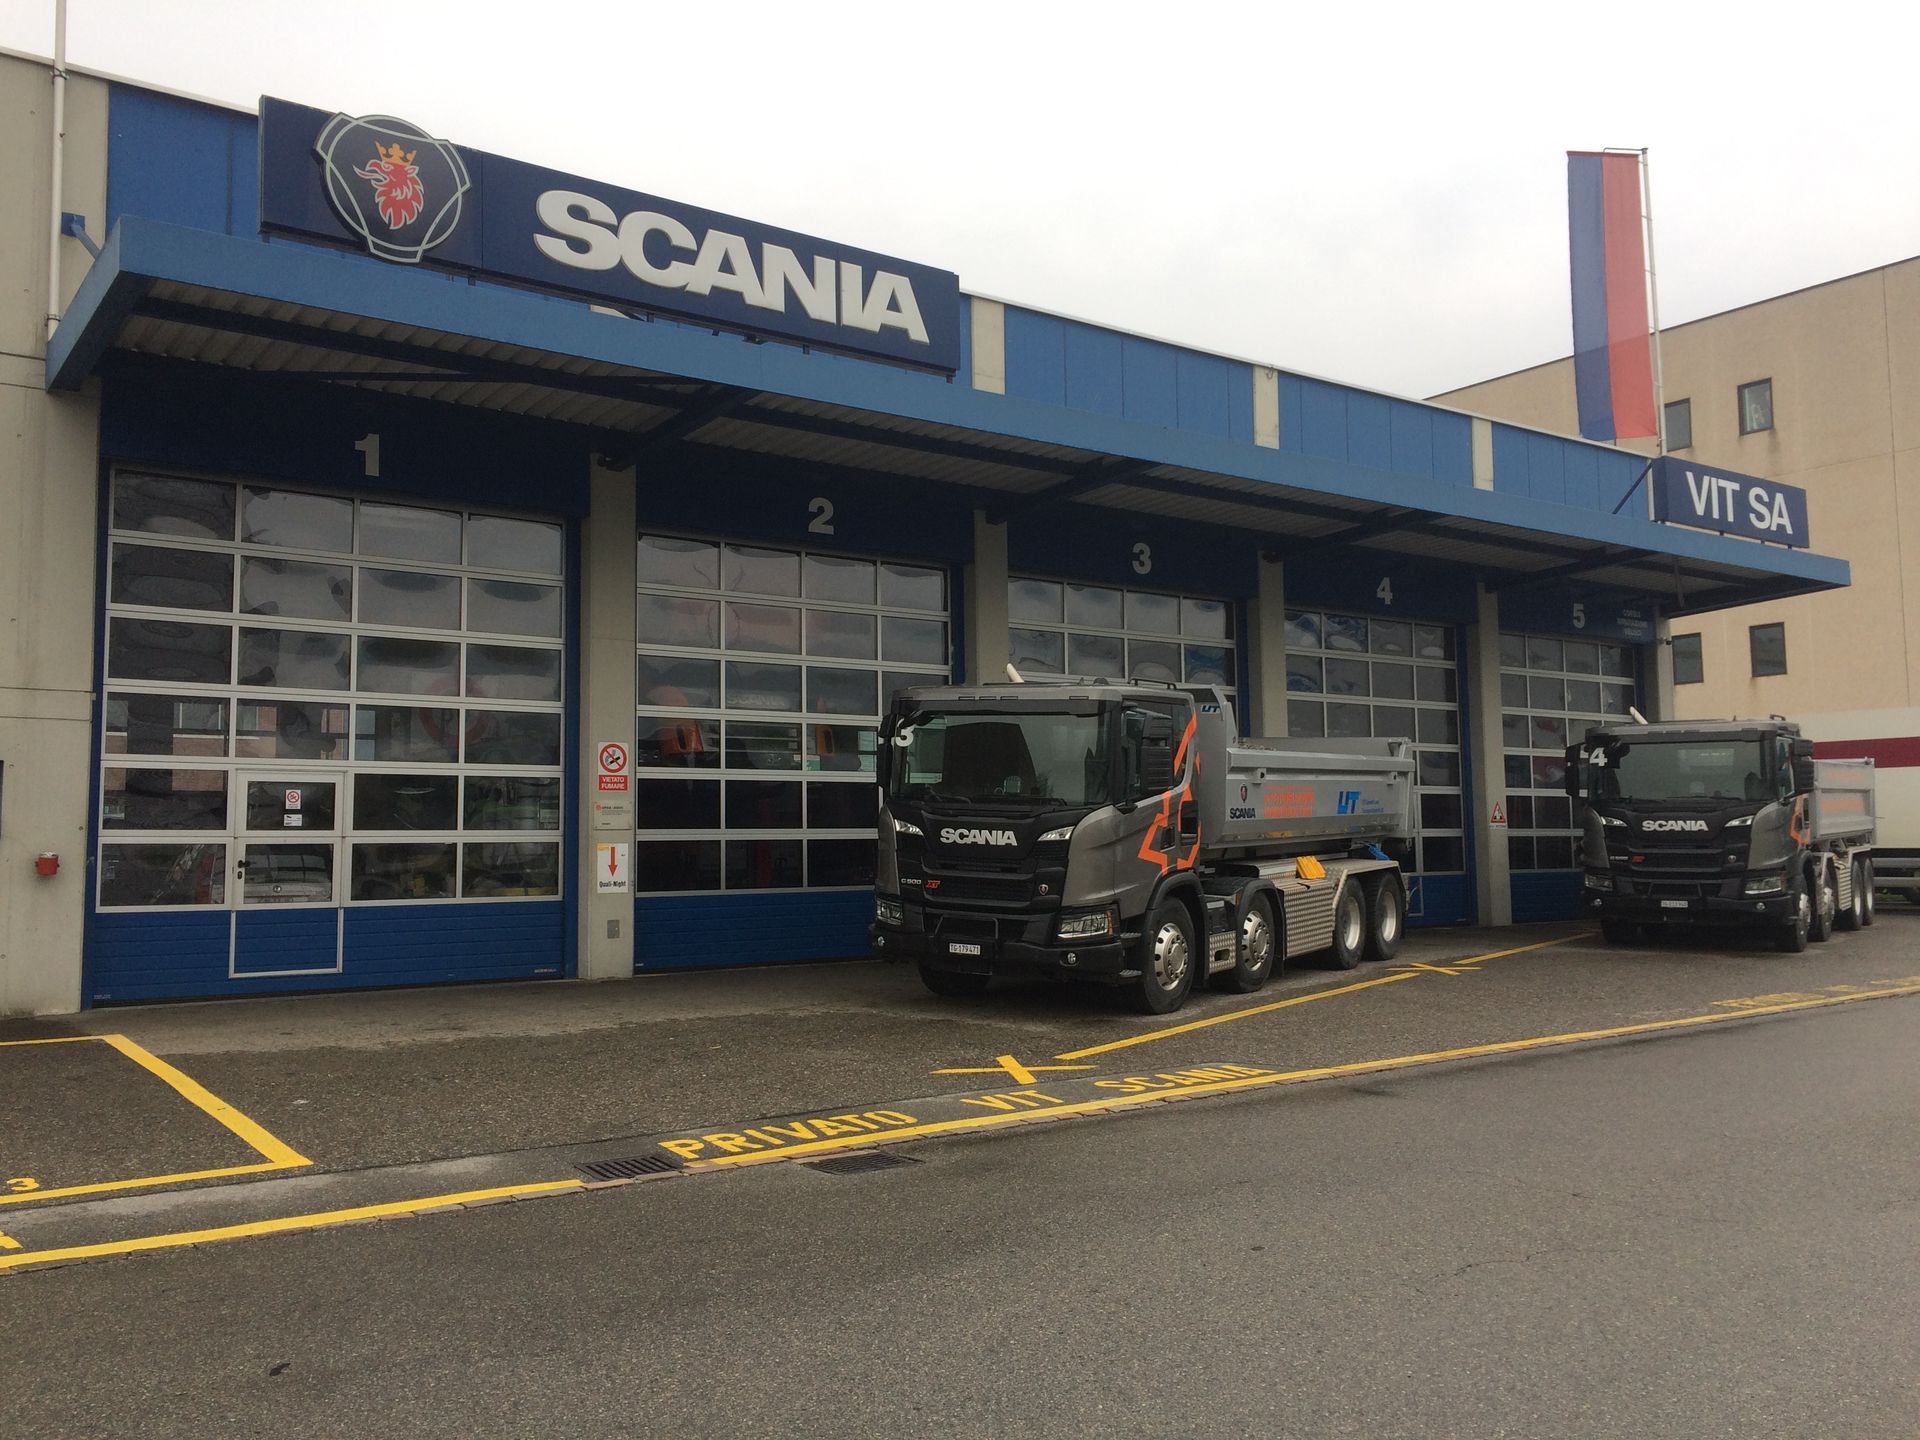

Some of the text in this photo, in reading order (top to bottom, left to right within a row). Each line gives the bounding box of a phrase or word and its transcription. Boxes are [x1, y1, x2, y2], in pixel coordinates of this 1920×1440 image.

[533, 190, 930, 345] SCANIA
[354, 433, 381, 477] 1
[807, 497, 835, 535] 2
[1685, 471, 1793, 535] VIT SA
[1131, 543, 1152, 575] 3
[1376, 576, 1393, 605] 4
[1572, 603, 1586, 629] 5
[1589, 747, 1608, 767] 4
[1230, 808, 1256, 820] SCANIA
[1642, 820, 1709, 832] SCANIA
[940, 828, 1018, 846] SCANIA
[926, 880, 941, 889] XT
[961, 1065, 1276, 1112] VIT SCANIA
[658, 1110, 918, 1158] PRIVATO
[6, 1177, 40, 1191] 3
